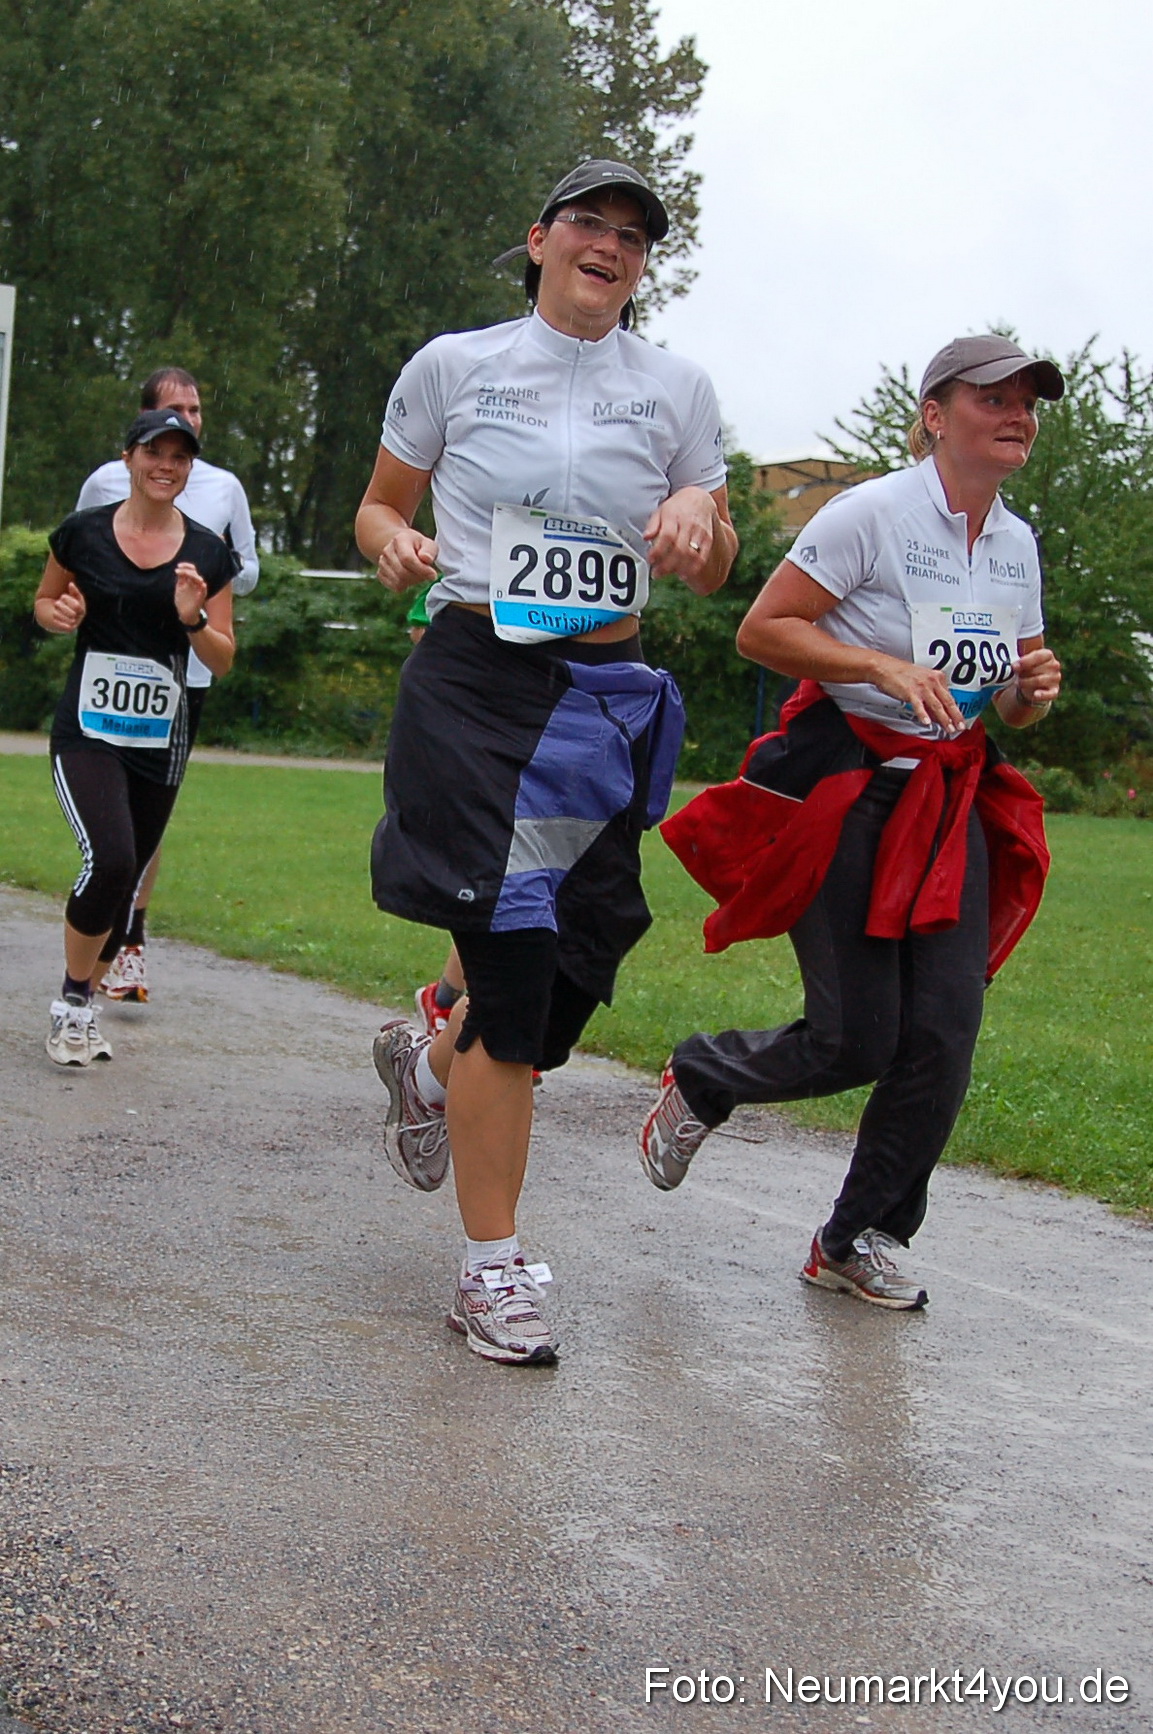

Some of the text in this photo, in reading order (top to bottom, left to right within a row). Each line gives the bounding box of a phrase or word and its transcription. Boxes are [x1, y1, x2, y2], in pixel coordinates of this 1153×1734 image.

[477, 395, 519, 409] CELLER
[500, 386, 541, 401] JAHRE
[475, 408, 548, 428] TRIATHLON
[593, 400, 656, 419] Mobil
[544, 518, 608, 537] BOCK
[907, 539, 950, 560] 25 JAHRE
[906, 552, 938, 568] CELLER
[989, 557, 1025, 579] Mobil
[508, 544, 637, 608] 2899
[905, 565, 960, 585] TRIATHLON
[953, 612, 992, 626] BOCK
[928, 639, 1015, 686] 2898
[91, 678, 170, 716] 3005
[101, 717, 150, 735] Melanie
